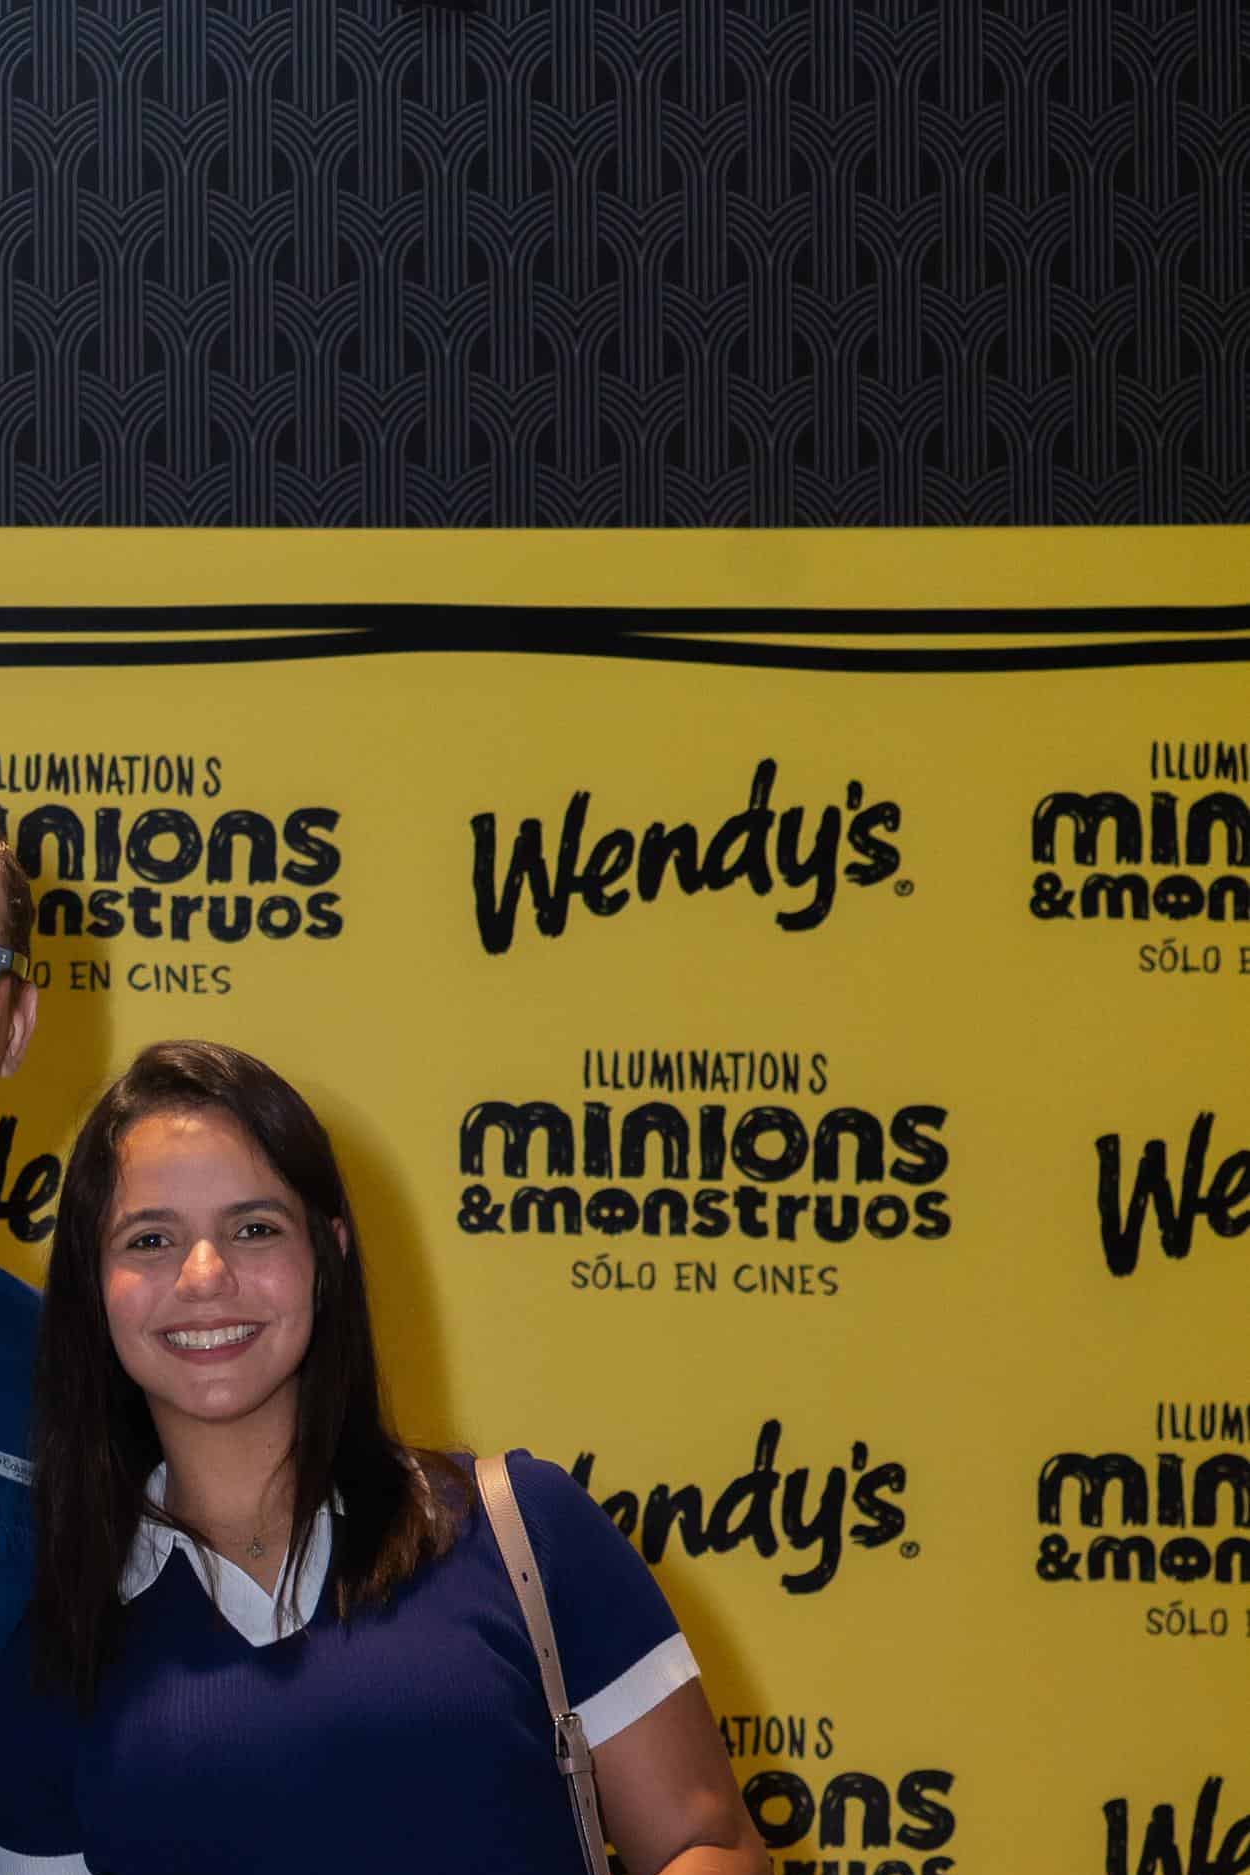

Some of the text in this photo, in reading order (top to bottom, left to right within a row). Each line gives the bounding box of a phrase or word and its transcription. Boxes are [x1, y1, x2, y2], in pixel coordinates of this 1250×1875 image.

[1139, 938, 1221, 974] SÓLO
[71, 962, 111, 991] EN
[127, 963, 232, 995] CINES
[583, 1049, 829, 1096] ILLUMINATIONS
[459, 1101, 949, 1187] minions
[456, 1184, 952, 1244] &monstruos
[572, 1254, 839, 1296] SÓLO EN CINES
[1146, 1600, 1228, 1637] SÓLO
